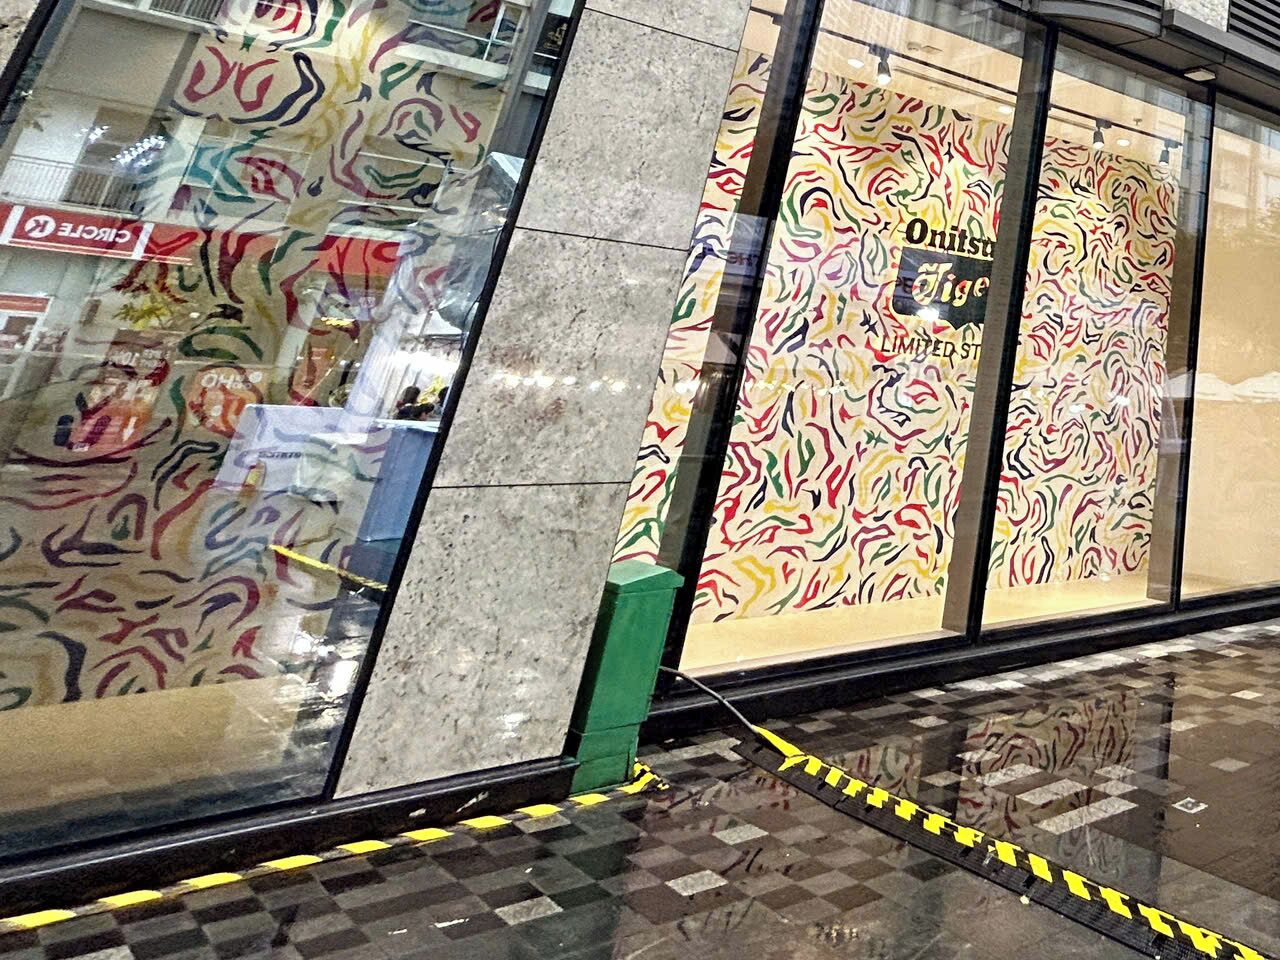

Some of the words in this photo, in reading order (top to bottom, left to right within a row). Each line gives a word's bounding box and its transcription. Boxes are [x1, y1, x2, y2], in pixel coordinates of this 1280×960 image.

[905, 217, 996, 258] Onitsu
[911, 262, 990, 307] Tige
[881, 333, 958, 358] LIMITED
[961, 342, 982, 360] ST
